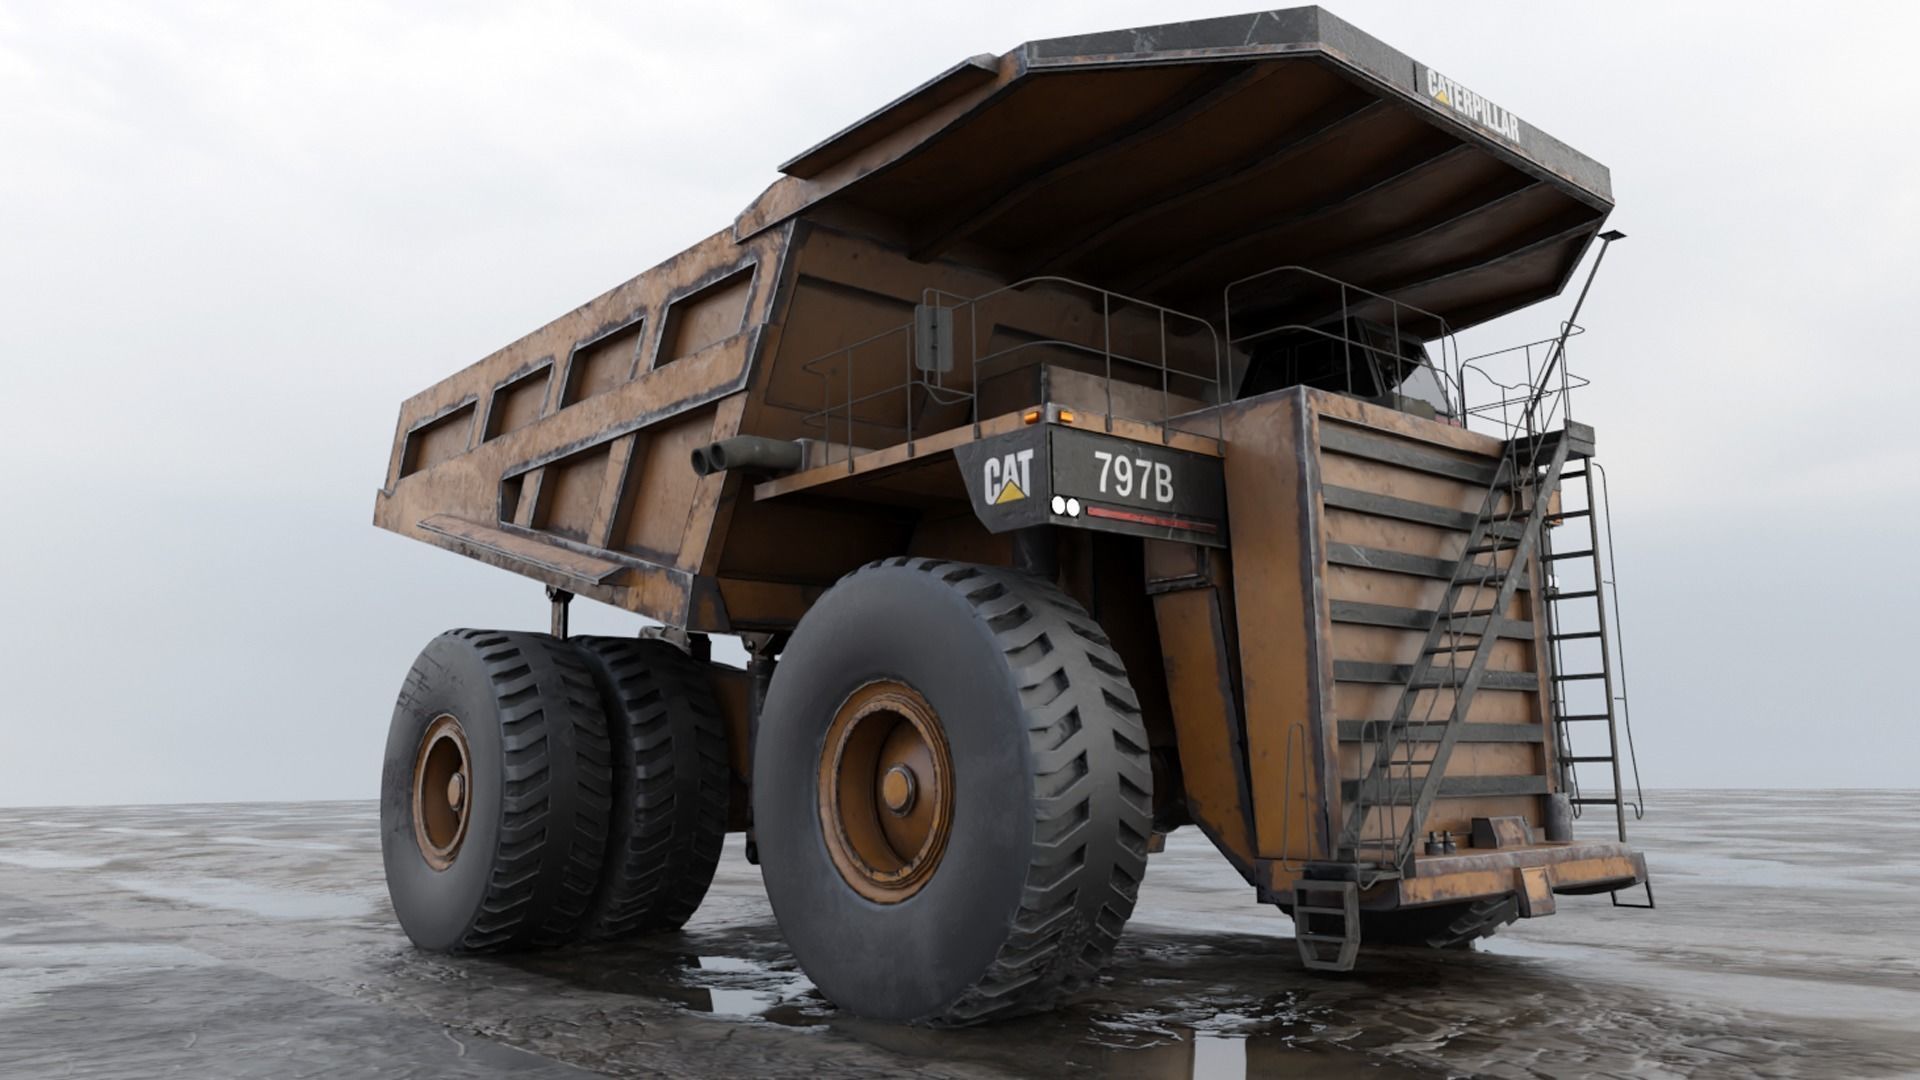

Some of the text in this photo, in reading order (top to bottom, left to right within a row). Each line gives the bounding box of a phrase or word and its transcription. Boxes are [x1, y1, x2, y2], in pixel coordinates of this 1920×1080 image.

[1426, 68, 1520, 143] CATERPILLAR
[984, 448, 1034, 505] CAT
[1094, 451, 1174, 503] 797B
